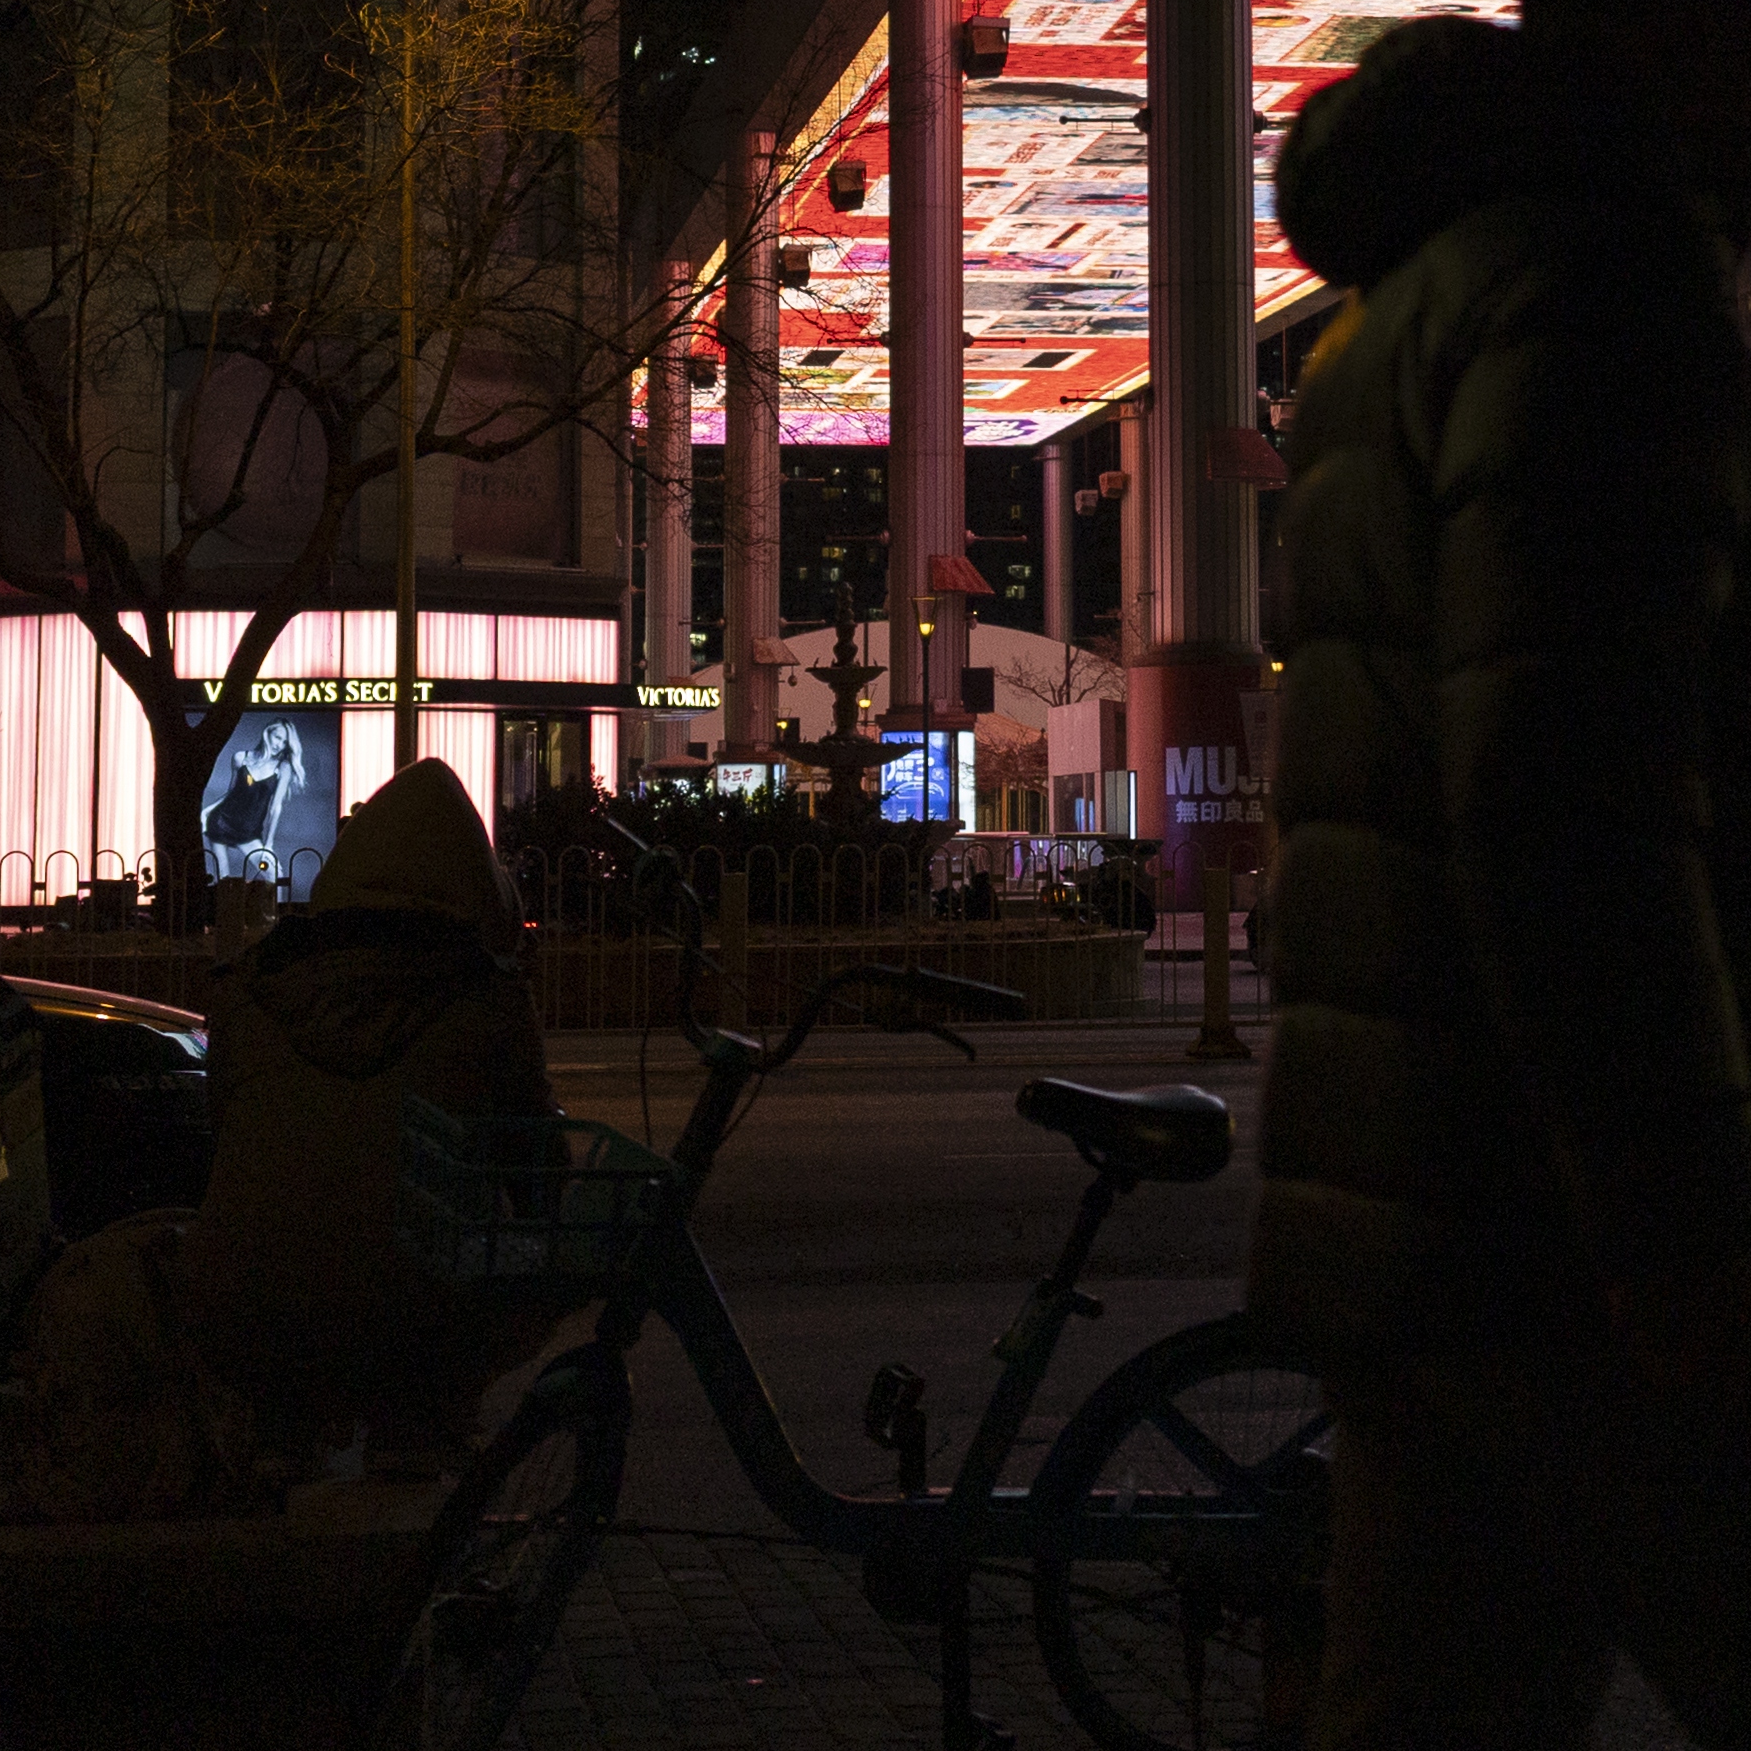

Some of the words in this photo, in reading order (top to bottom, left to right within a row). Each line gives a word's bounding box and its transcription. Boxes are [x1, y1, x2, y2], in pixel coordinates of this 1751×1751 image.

[202, 680, 338, 704] VTORIA'S
[636, 685, 722, 707] VICTORIA'S
[1175, 800, 1264, 823] 無印良品
